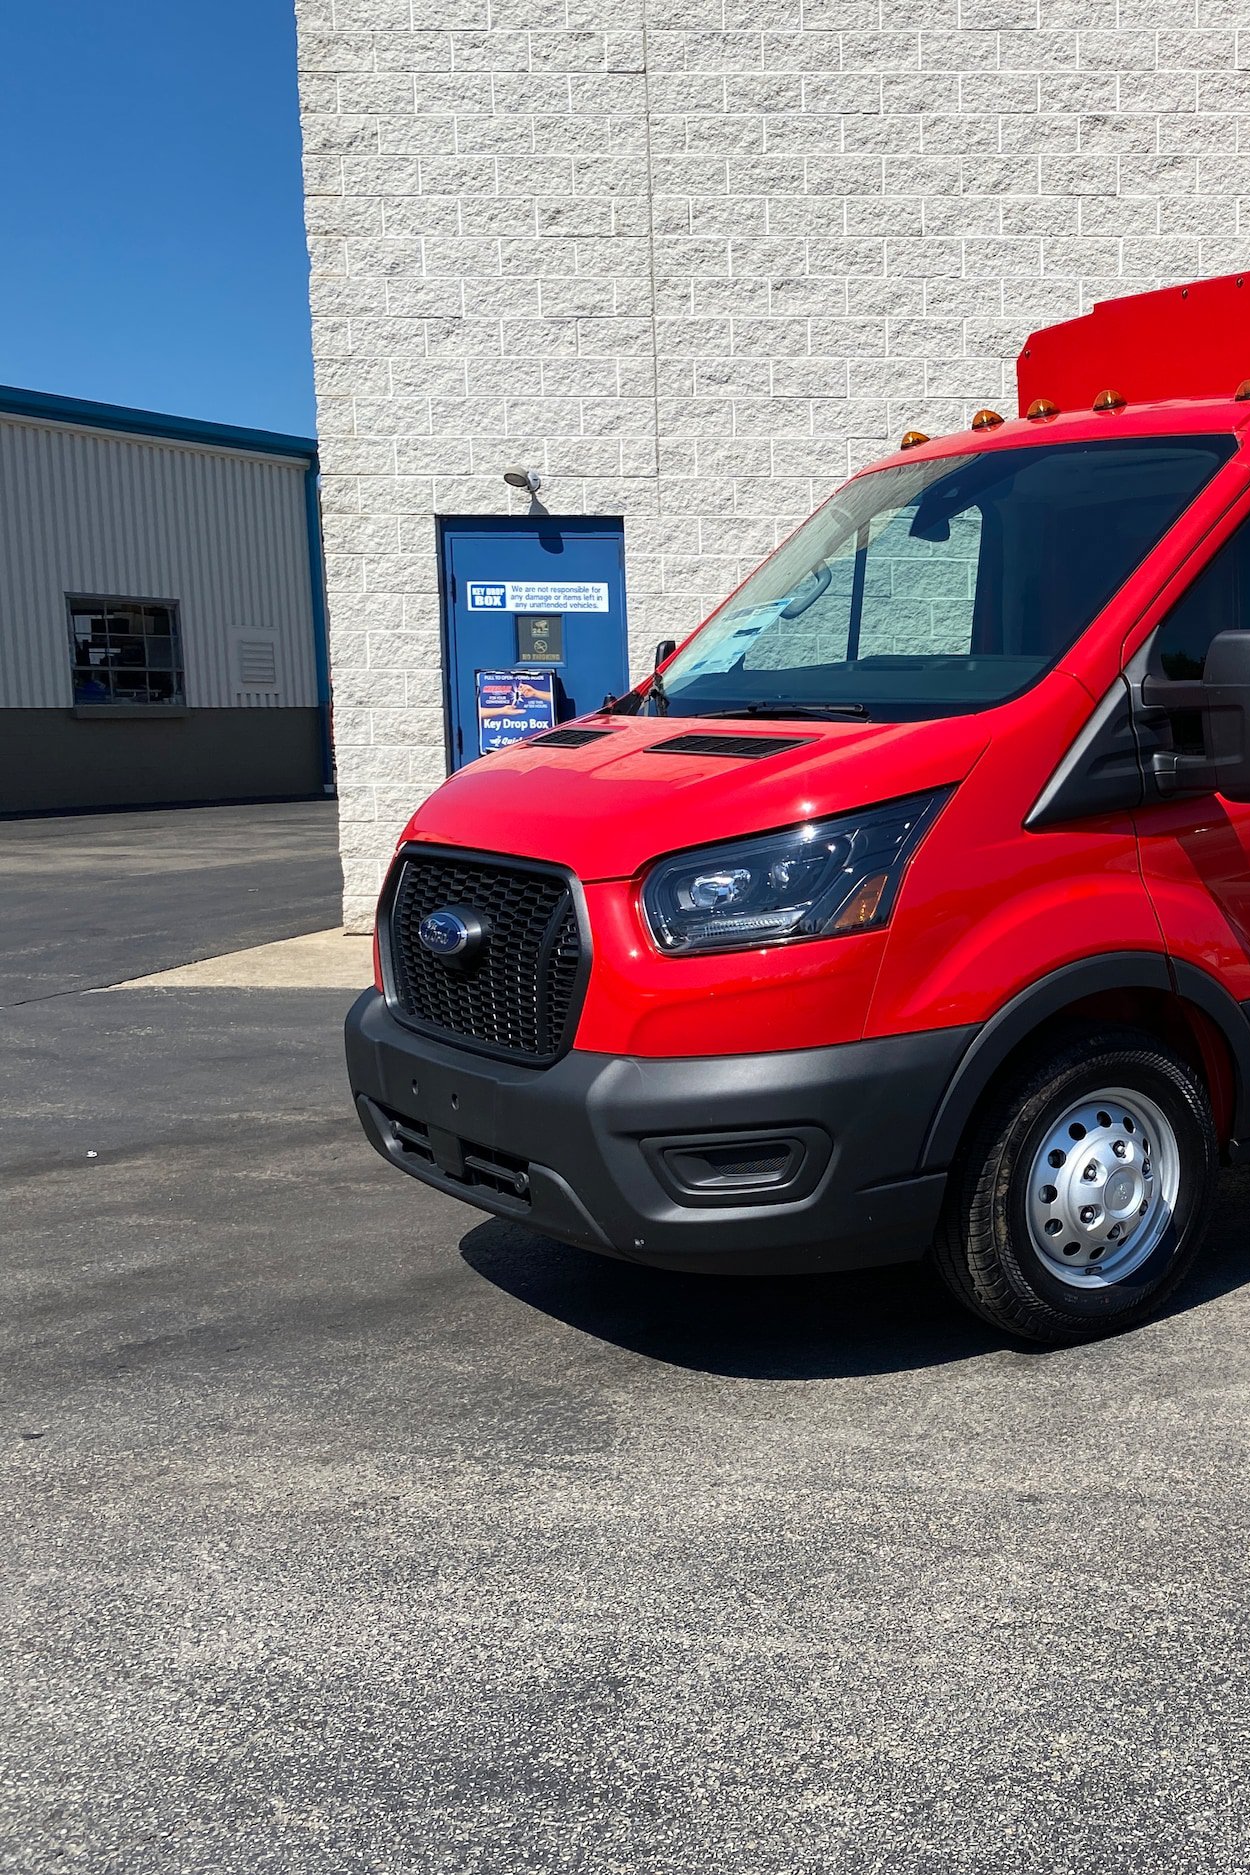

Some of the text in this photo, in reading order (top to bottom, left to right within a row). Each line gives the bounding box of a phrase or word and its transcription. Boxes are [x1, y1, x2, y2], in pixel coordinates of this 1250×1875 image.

[472, 587, 505, 595] KEY DROP
[511, 585, 523, 593] We
[550, 585, 590, 594] responsible
[591, 585, 601, 593] for
[474, 595, 502, 606] BOX
[525, 593, 552, 602] damage
[583, 593, 595, 601] left
[514, 601, 599, 610] any unattended vehicles.
[483, 718, 549, 731] Key Drop Box
